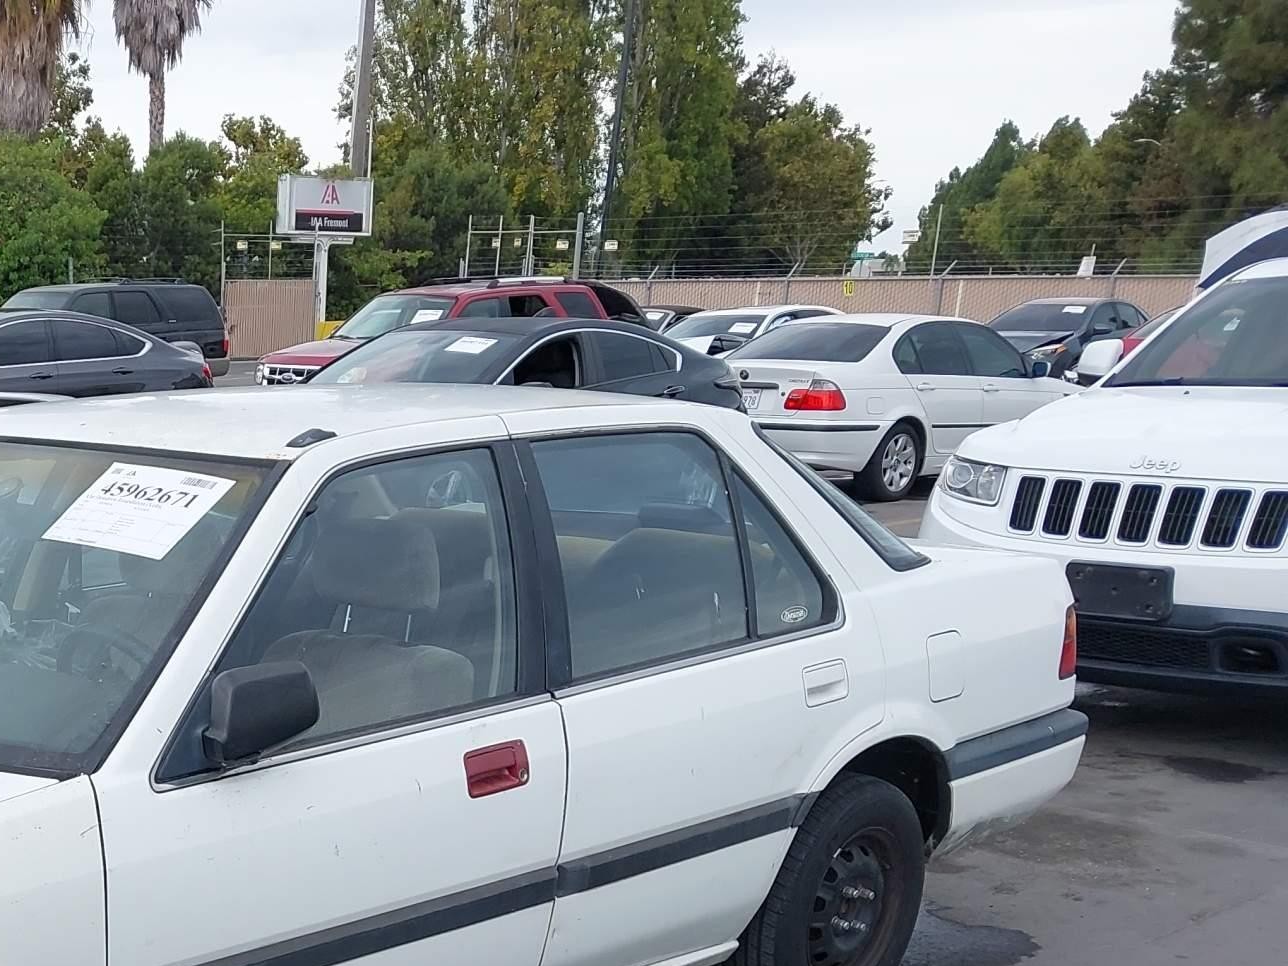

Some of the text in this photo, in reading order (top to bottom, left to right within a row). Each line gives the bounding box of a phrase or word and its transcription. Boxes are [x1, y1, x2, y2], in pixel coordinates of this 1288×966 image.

[323, 217, 349, 228] Fremont
[1128, 455, 1182, 474] Jeep
[101, 480, 200, 508] 45962671
